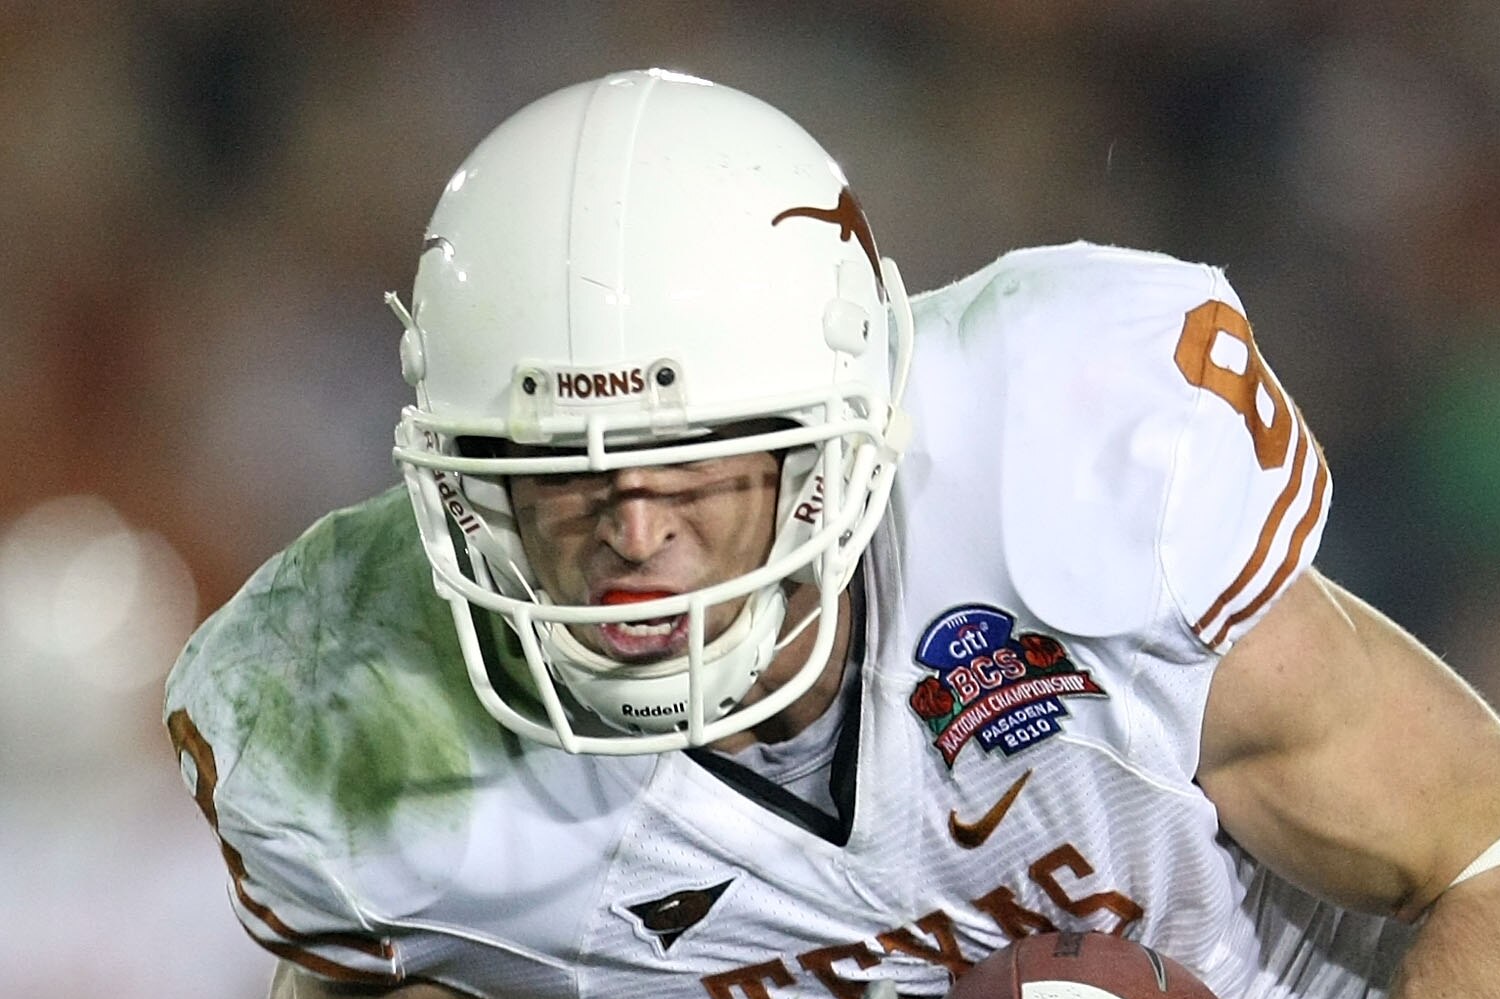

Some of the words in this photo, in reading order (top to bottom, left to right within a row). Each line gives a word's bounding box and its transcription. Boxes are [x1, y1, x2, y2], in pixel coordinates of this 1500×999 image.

[557, 368, 645, 399] HORNS
[1174, 299, 1293, 471] 8
[949, 630, 988, 659] citi
[946, 648, 1026, 706] BCS
[621, 702, 685, 717] Riddell
[942, 703, 992, 754] NATIONAL
[988, 675, 1086, 713] CHAMPIONSHIP
[982, 701, 1060, 744] PASADENA
[1004, 718, 1052, 748] 2010
